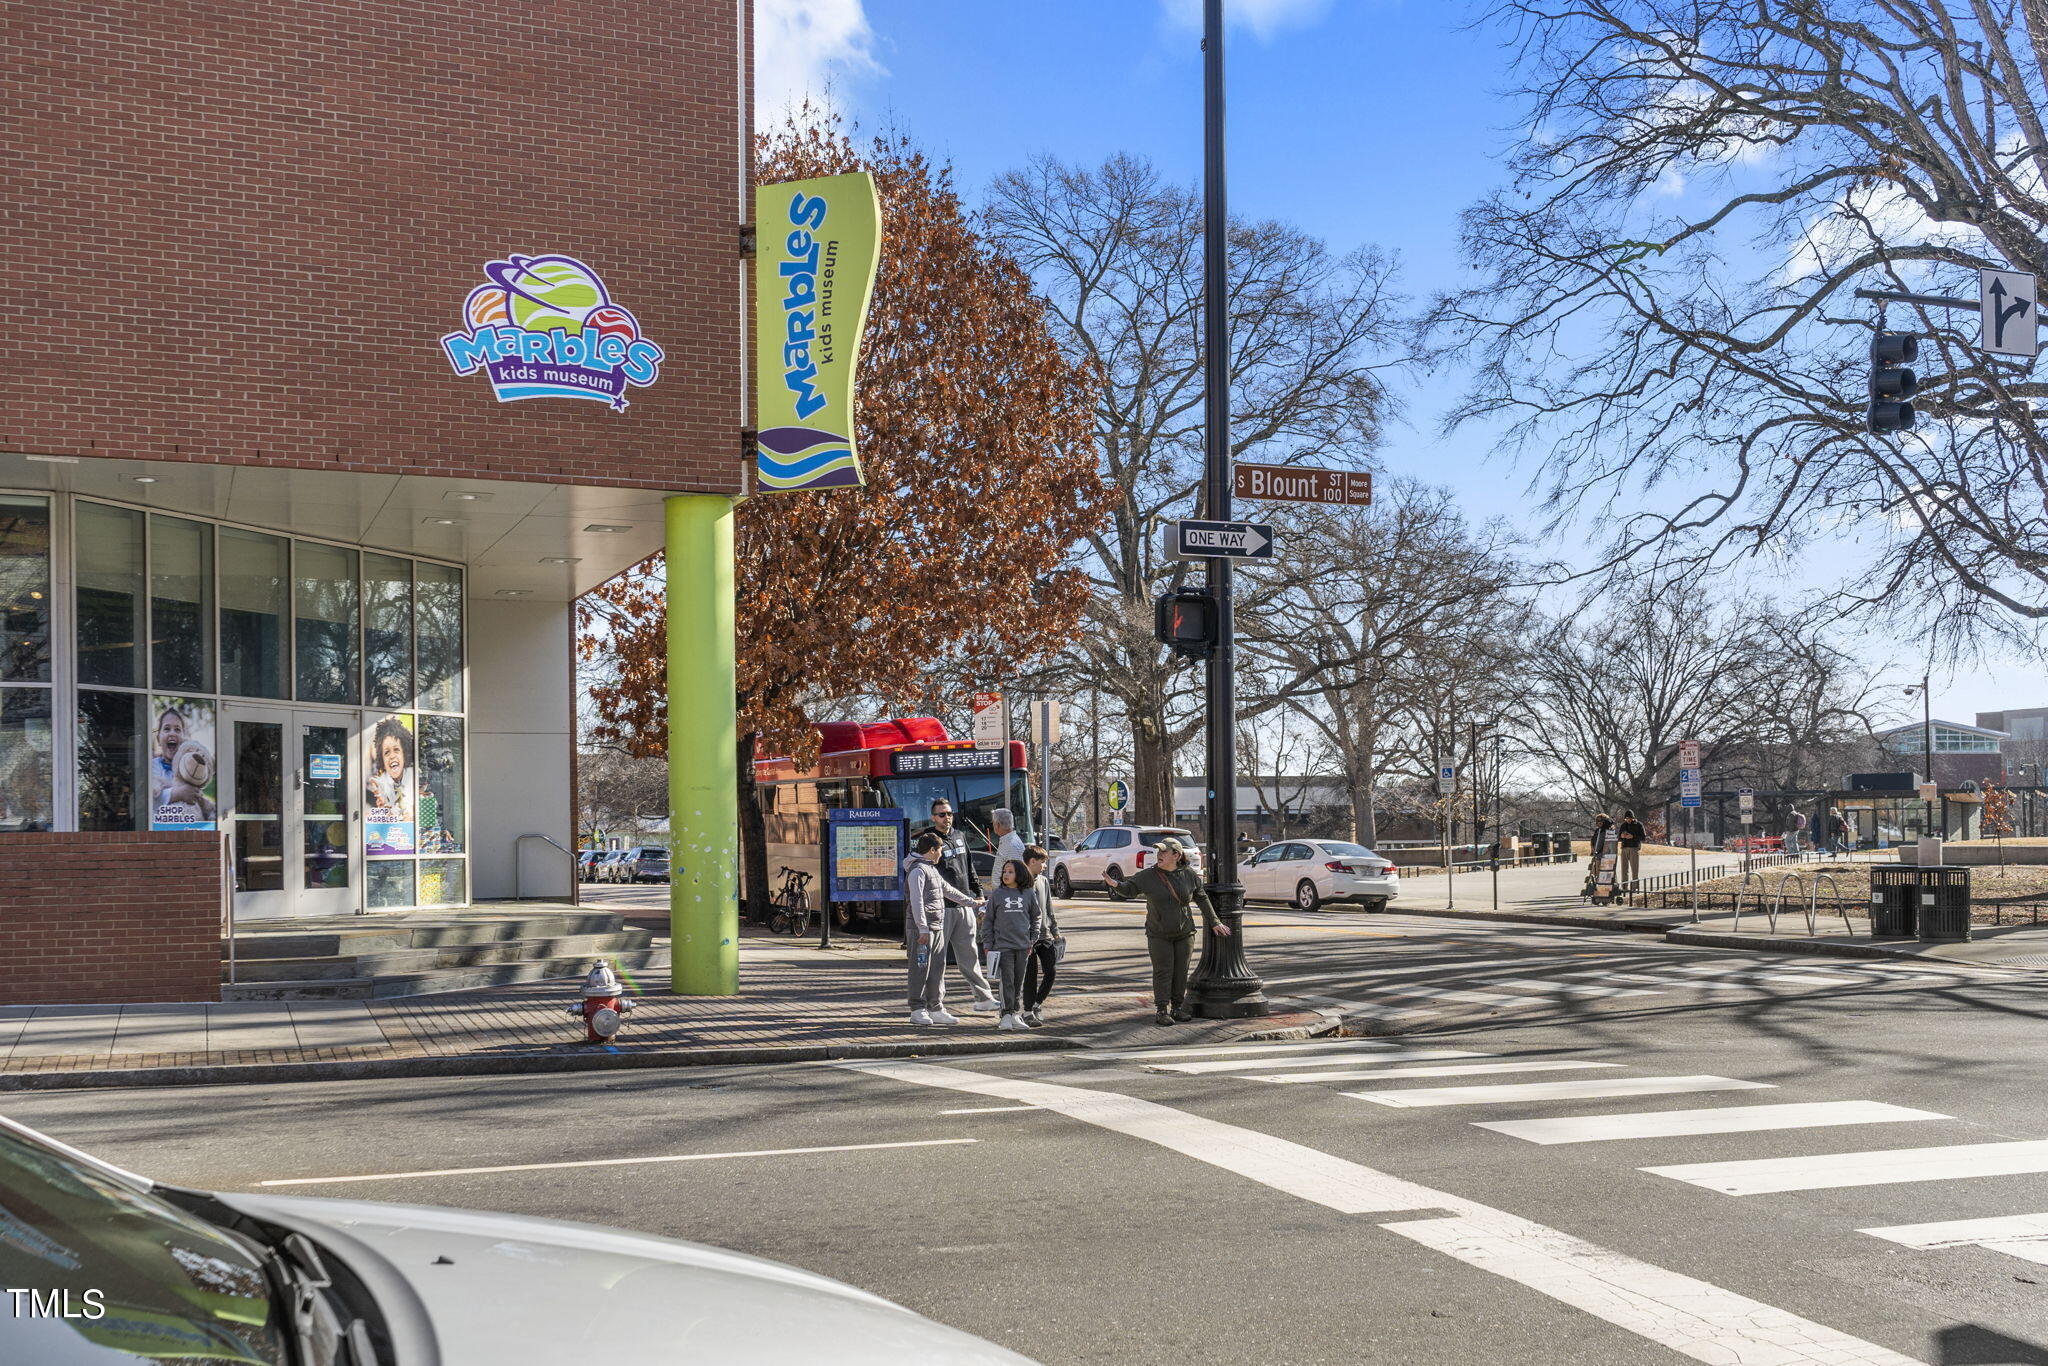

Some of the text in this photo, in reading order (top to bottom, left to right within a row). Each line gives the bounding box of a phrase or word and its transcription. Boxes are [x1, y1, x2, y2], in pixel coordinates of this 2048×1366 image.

[821, 239, 839, 365] kids museum
[500, 365, 614, 392] kids museum
[1238, 470, 1342, 498] S Blount ST
[1350, 479, 1368, 488] Moore
[1323, 488, 1342, 502] 100
[1349, 489, 1369, 500] Square
[1189, 531, 1246, 547] ONE WAY
[900, 751, 1000, 770] NOT IN SERVICE
[1681, 770, 1688, 781] 2
[160, 806, 184, 814] SHOP
[371, 808, 389, 816] SHOP
